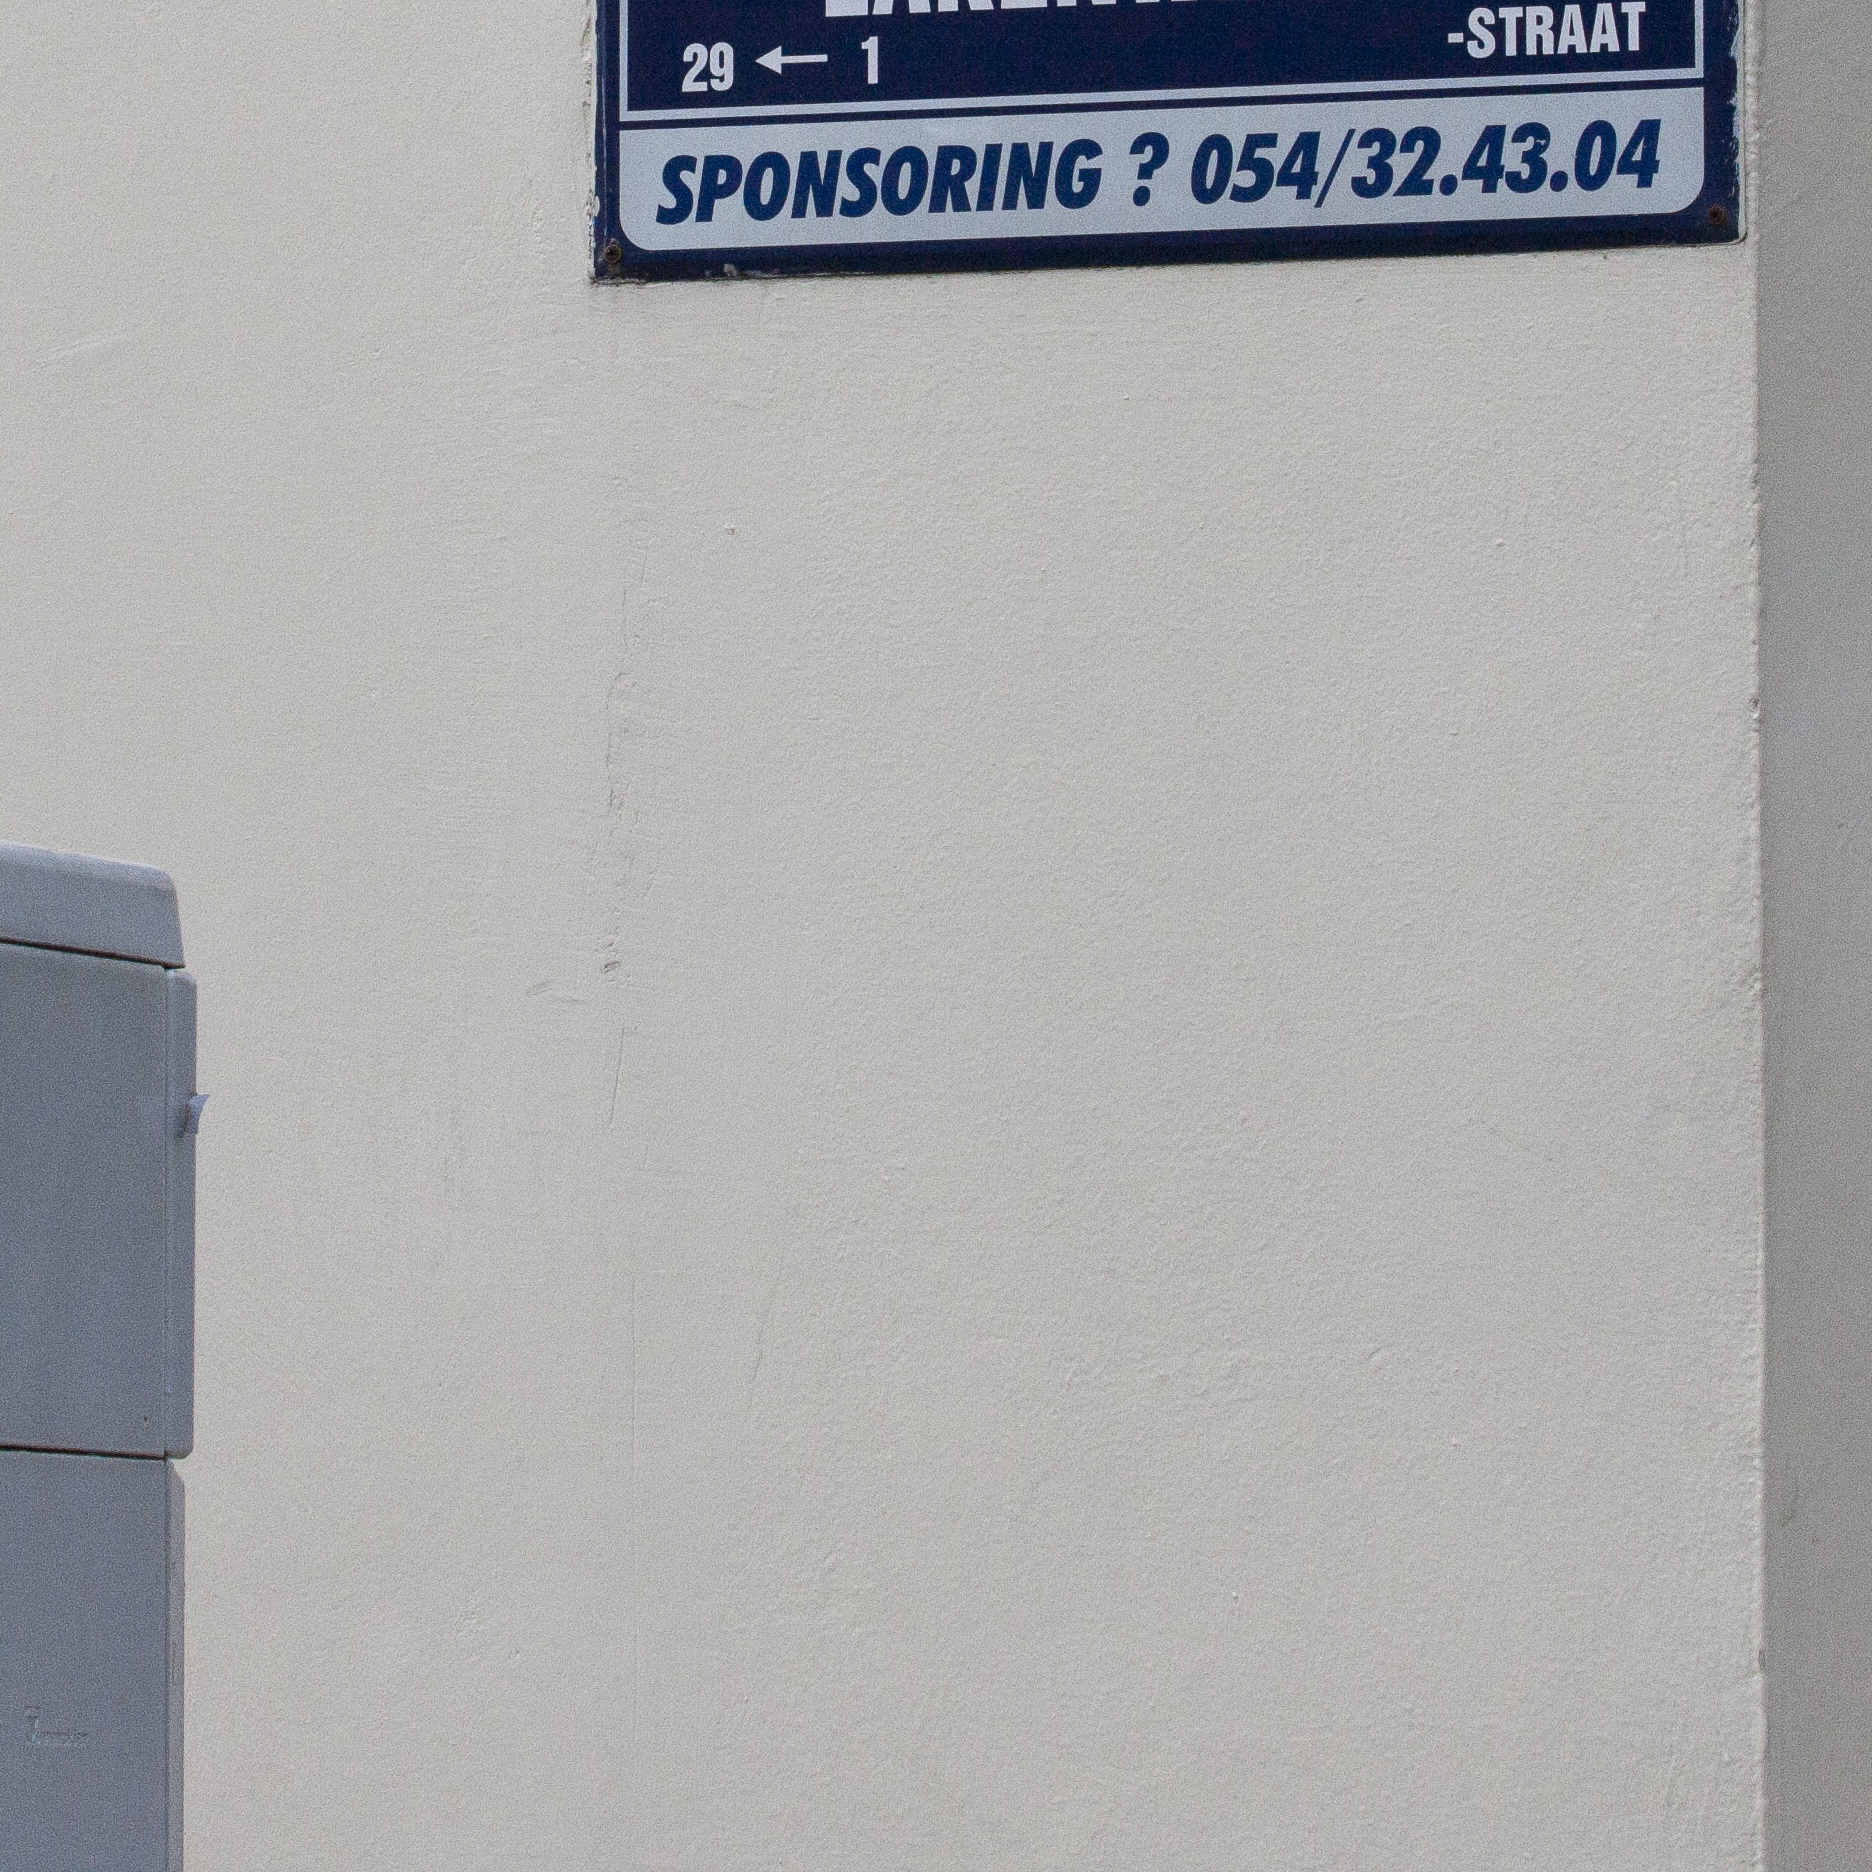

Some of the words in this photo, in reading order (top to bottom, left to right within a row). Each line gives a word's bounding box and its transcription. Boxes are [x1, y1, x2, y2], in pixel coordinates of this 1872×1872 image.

[1447, 0, 1647, 60] -STRAAT
[681, 42, 734, 93] 29
[861, 36, 880, 84] 1
[655, 140, 1102, 226] SPONSORING
[1190, 119, 1662, 208] 054/32.43.04
